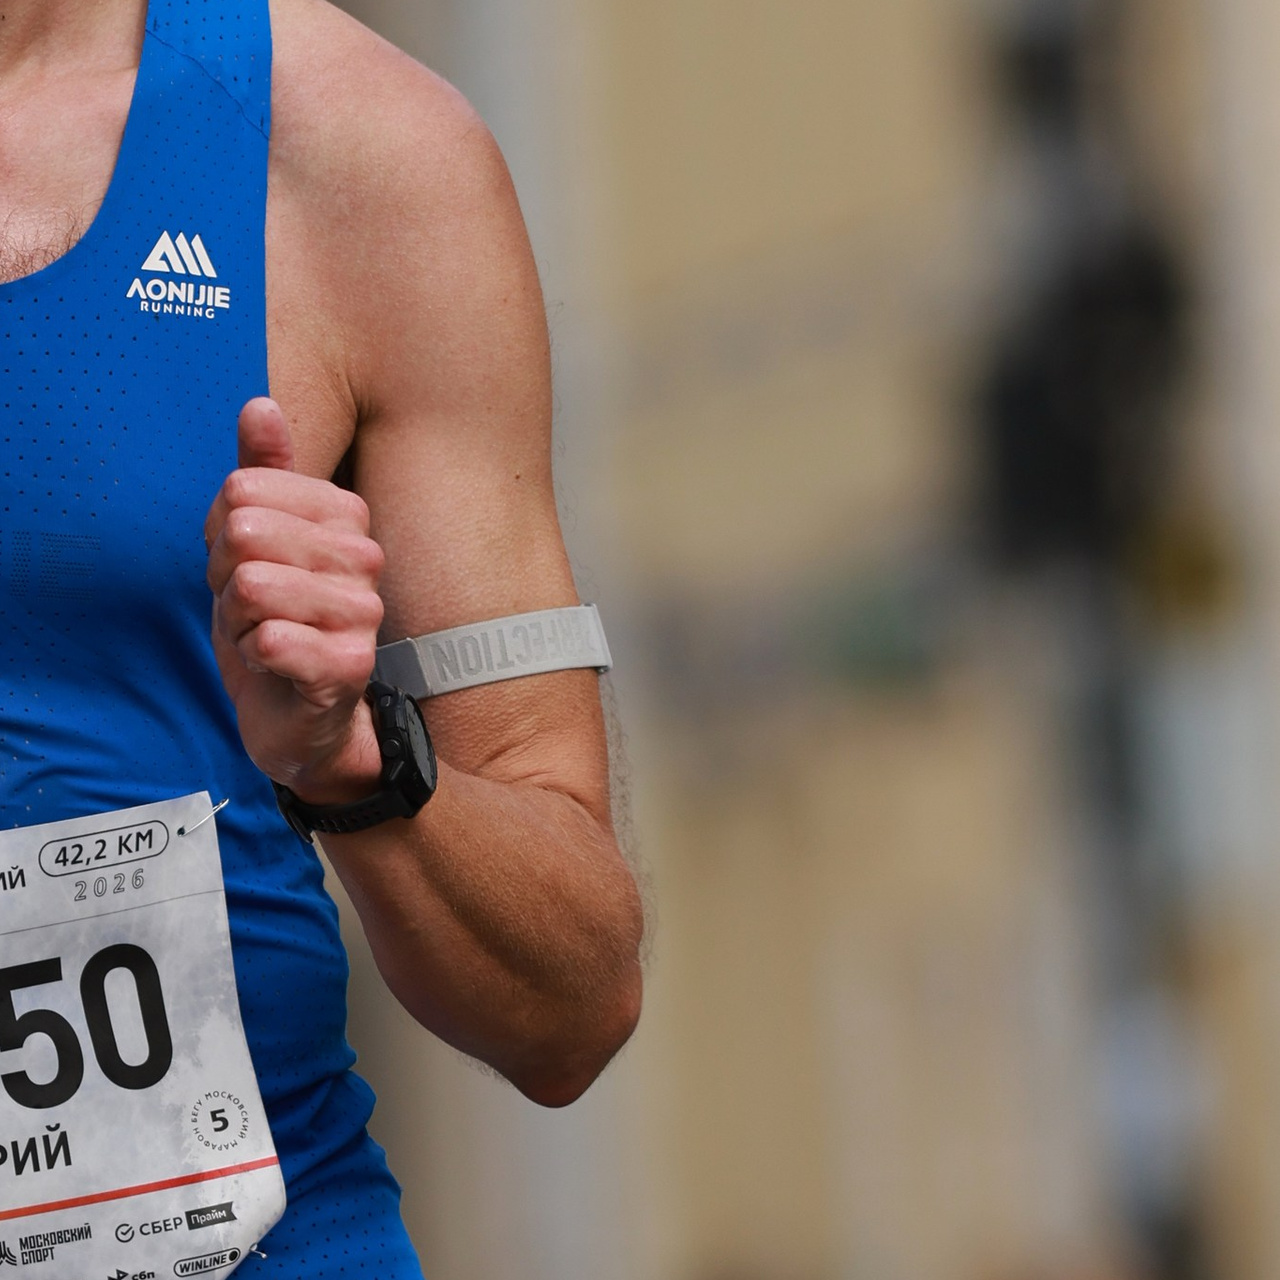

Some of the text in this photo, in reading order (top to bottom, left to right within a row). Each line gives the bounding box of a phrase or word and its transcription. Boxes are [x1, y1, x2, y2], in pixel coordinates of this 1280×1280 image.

[126, 278, 230, 309] AONIJIE
[140, 301, 215, 319] RUNNING
[55, 829, 153, 866] 42,2 КМ
[74, 868, 144, 901] 2026
[191, 1090, 249, 1151] БЕГУ МОСКОВСКИЙ МАРАФОН
[210, 1108, 229, 1132] 5
[19, 1222, 92, 1251] МОСКОВСКИЙ
[139, 1209, 227, 1236] СБЕР Прайм
[21, 1247, 55, 1265] СПОРТ
[179, 1253, 227, 1273] WINLINE
